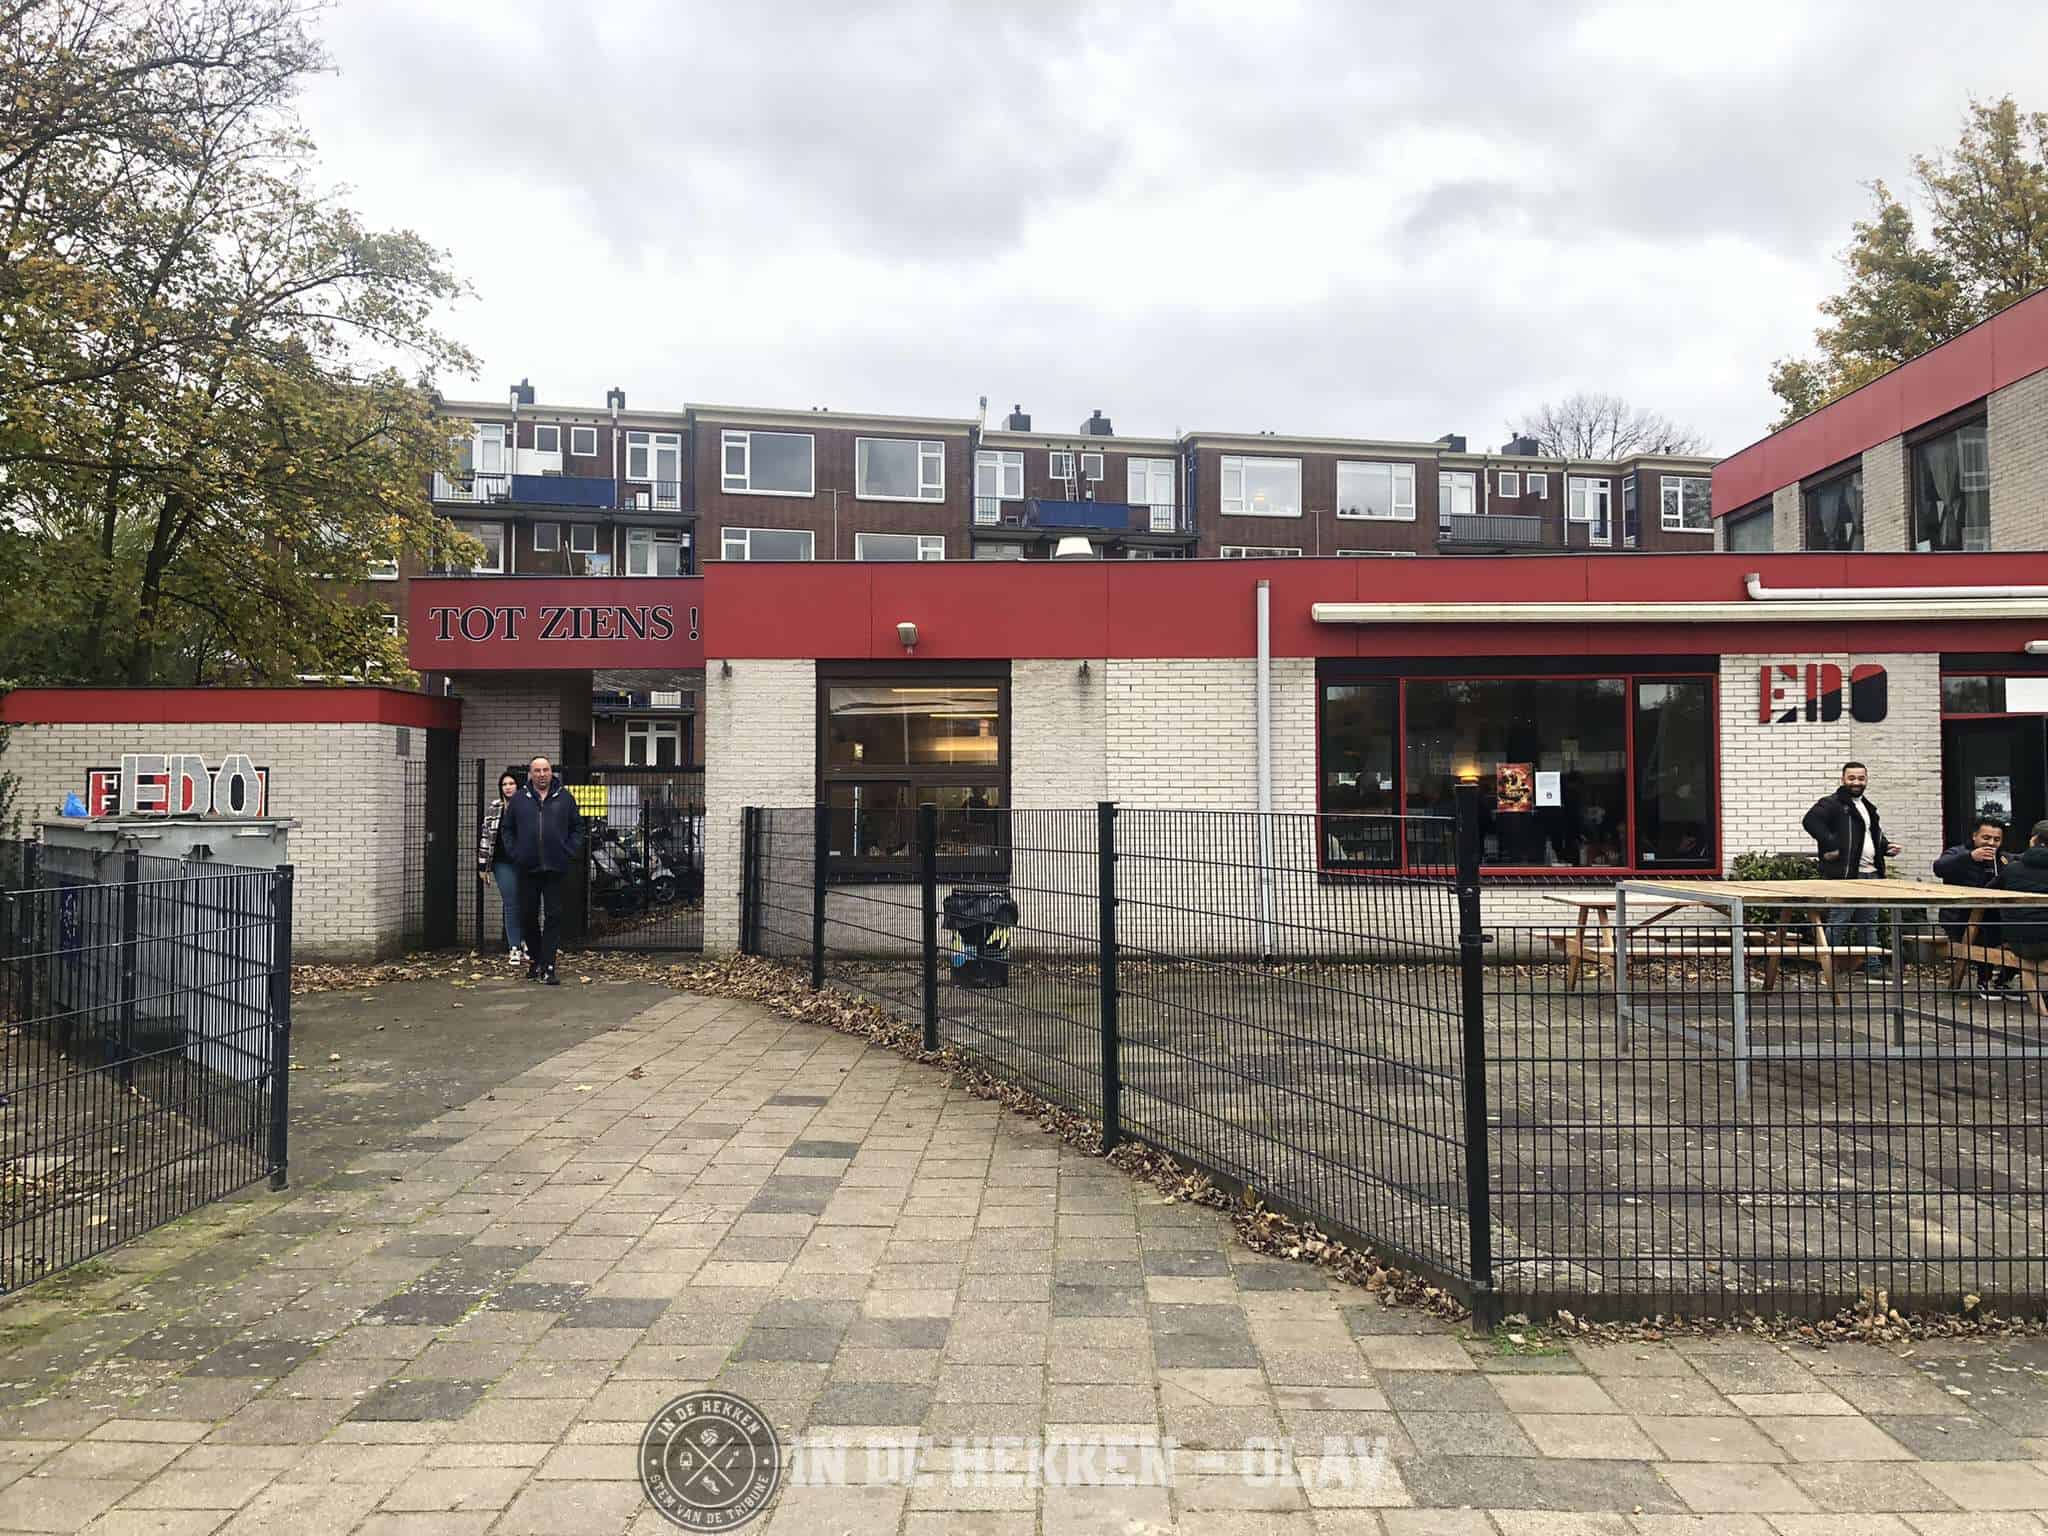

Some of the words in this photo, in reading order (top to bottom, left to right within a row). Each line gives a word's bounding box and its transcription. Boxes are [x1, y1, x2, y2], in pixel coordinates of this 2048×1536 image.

[429, 605, 526, 641] TOT
[538, 605, 675, 641] ZIENS
[1759, 663, 1888, 724] EDO
[120, 753, 262, 817] EDO
